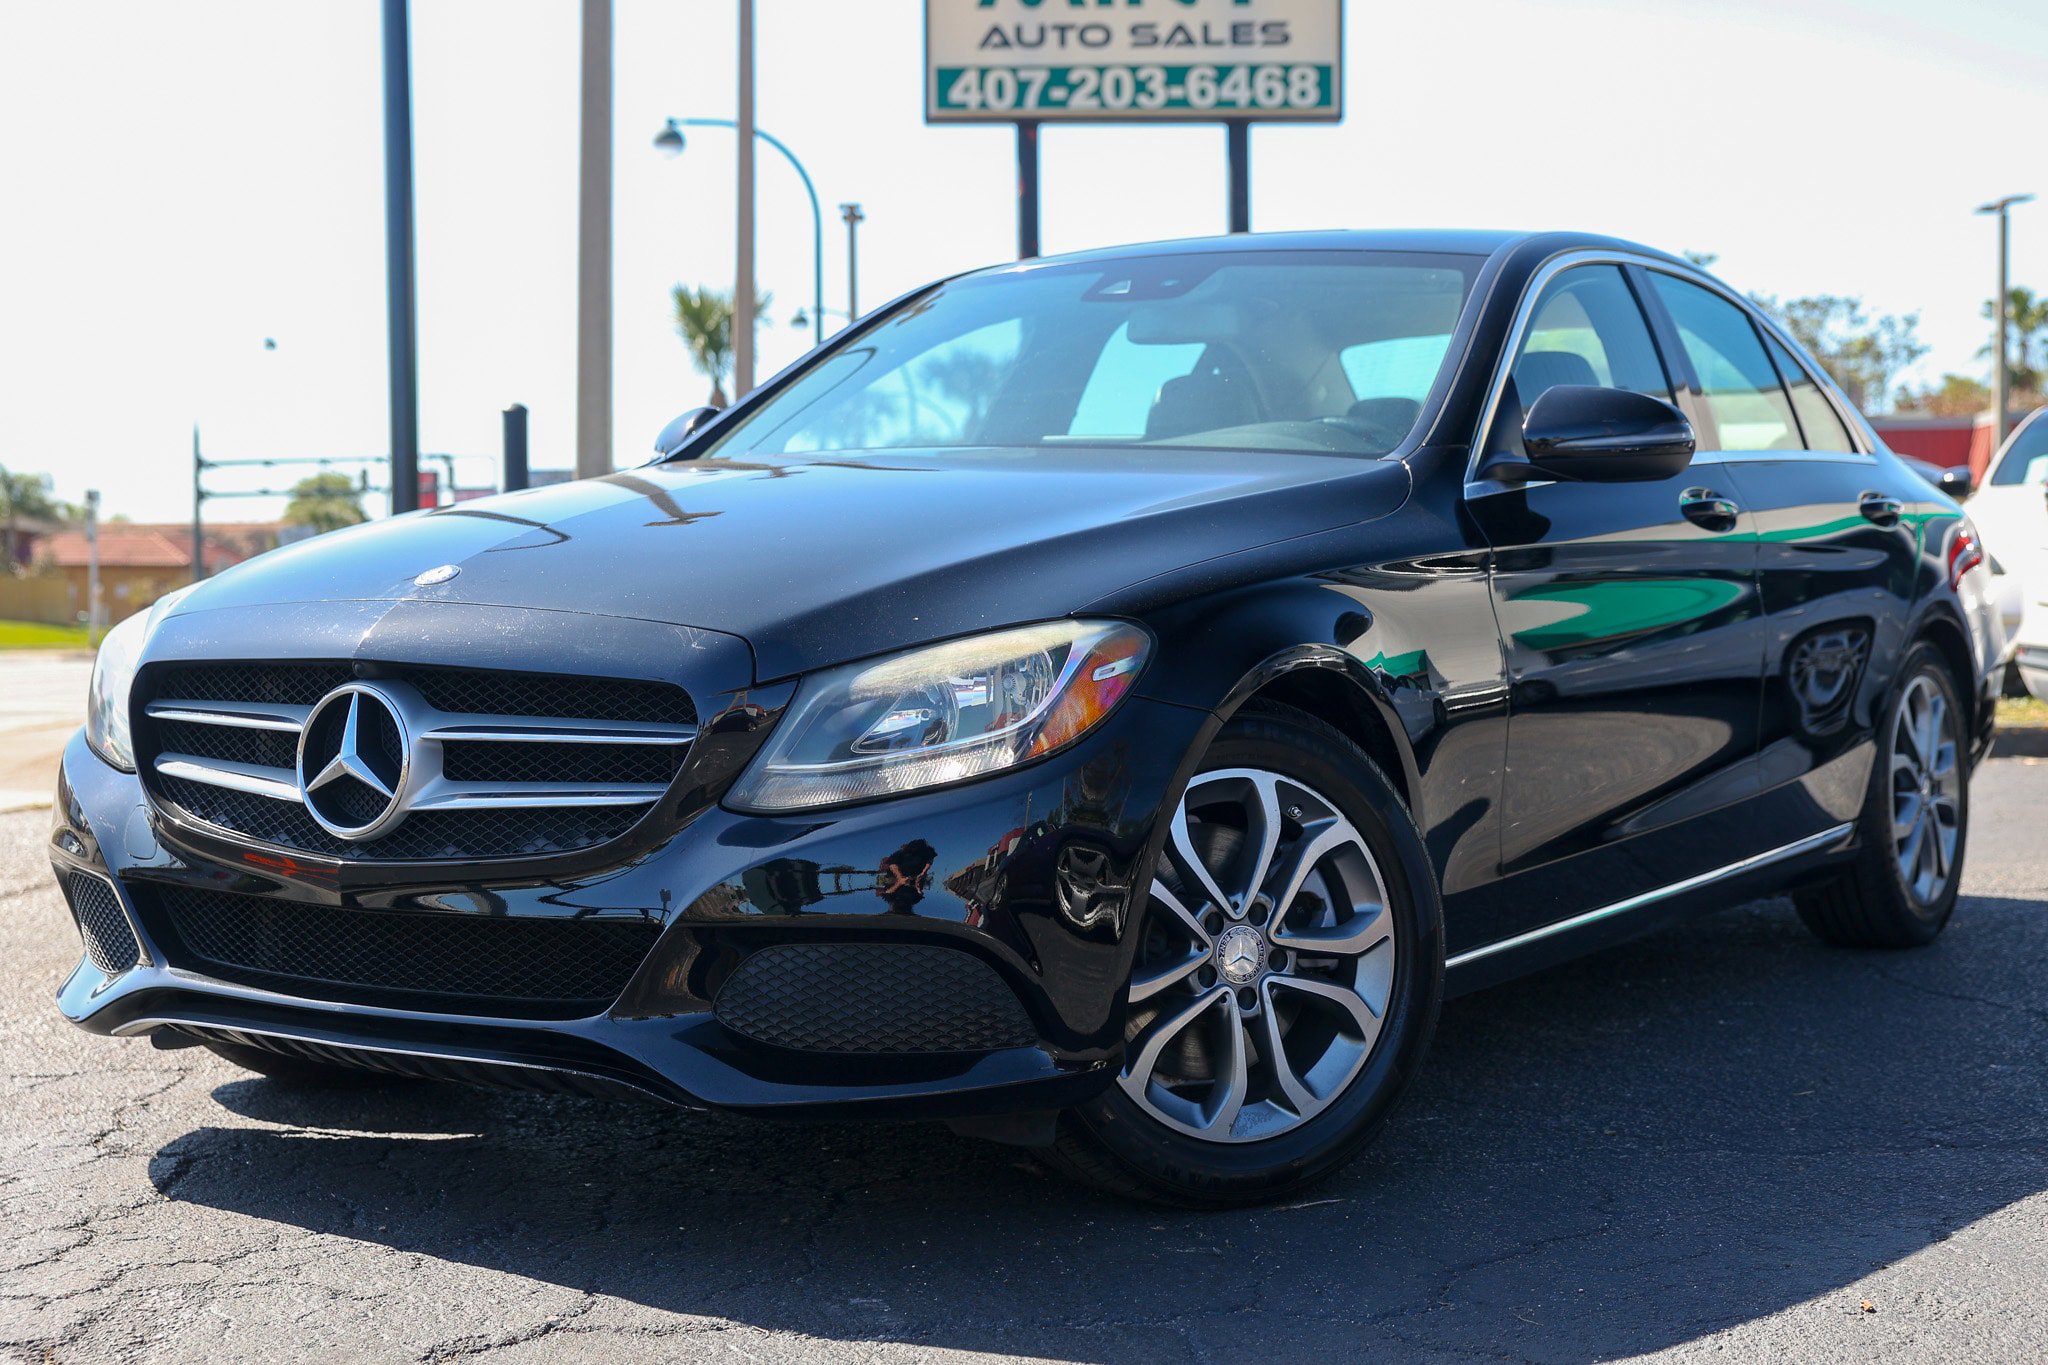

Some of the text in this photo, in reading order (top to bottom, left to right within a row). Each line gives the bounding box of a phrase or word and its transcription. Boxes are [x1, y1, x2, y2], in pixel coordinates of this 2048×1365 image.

[979, 22, 1292, 49] AUTO SALES
[947, 66, 1321, 110] 407-203-6468
